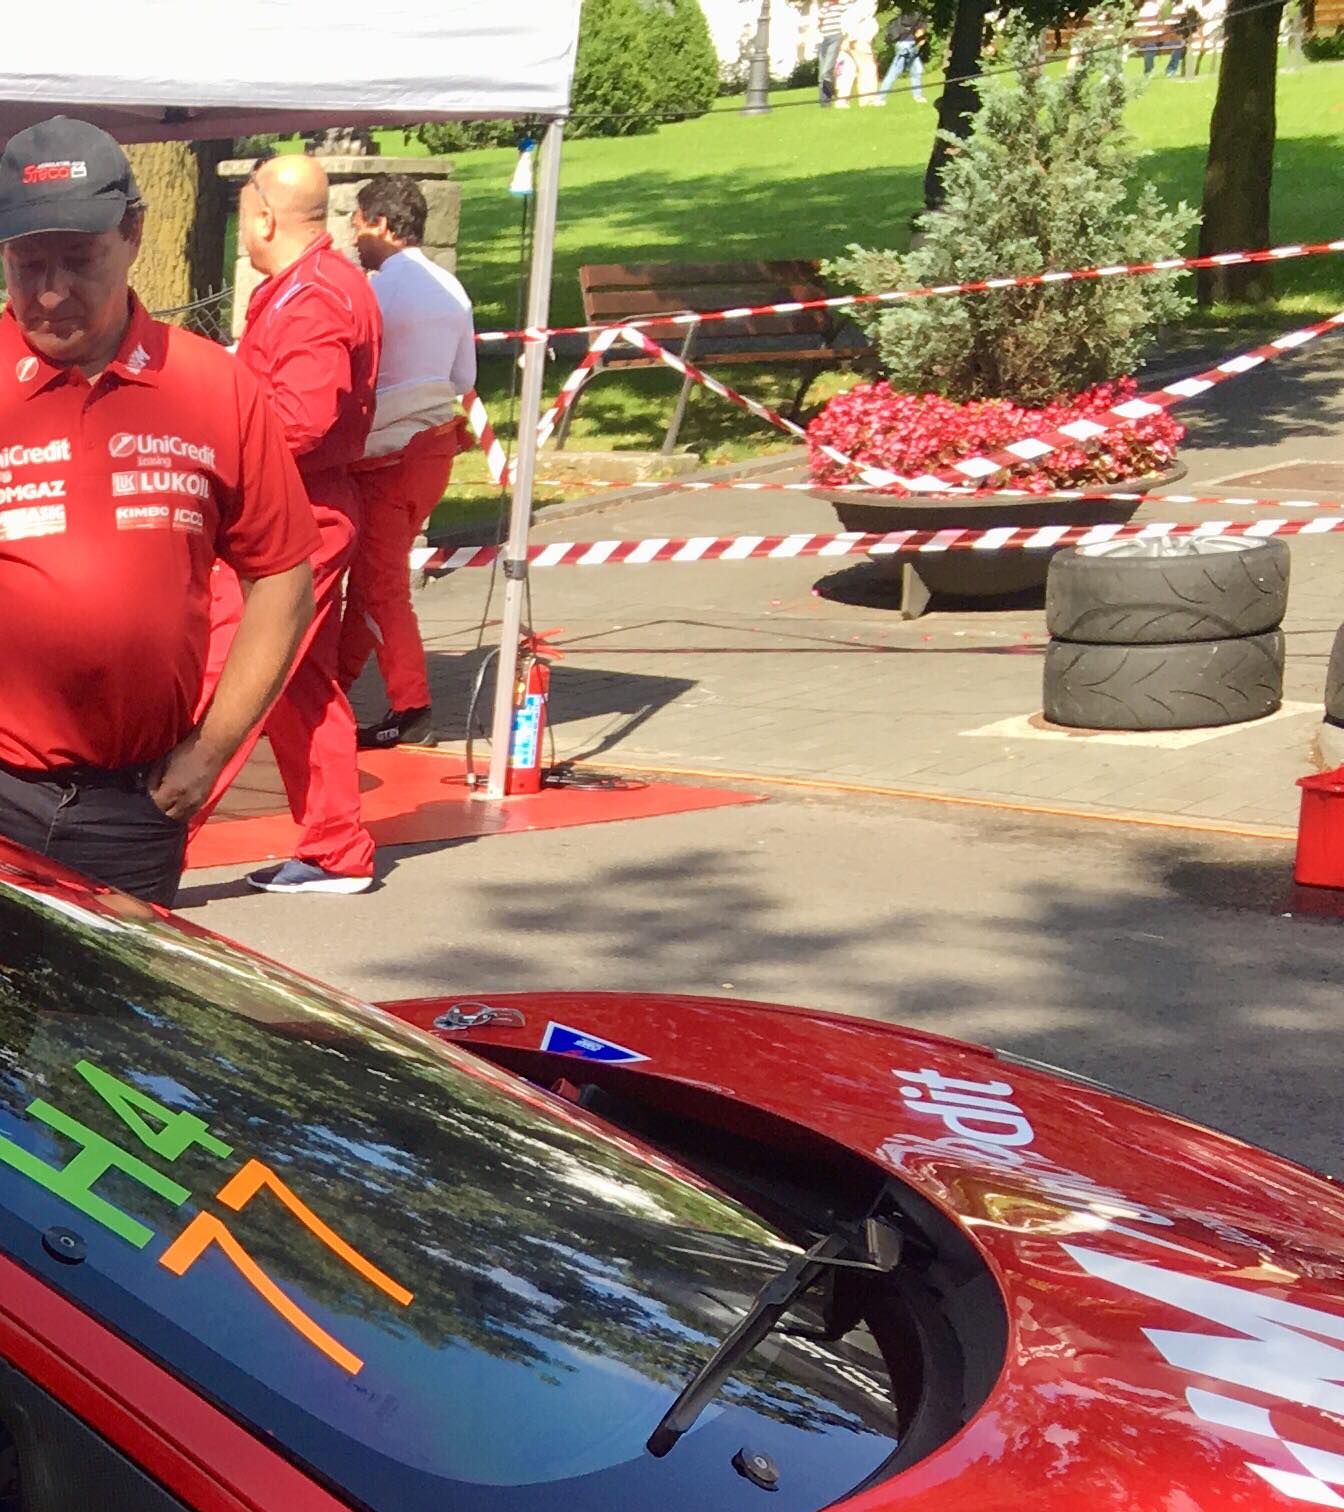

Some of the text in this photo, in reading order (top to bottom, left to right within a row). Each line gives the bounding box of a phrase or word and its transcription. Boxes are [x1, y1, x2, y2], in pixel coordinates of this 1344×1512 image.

[137, 434, 215, 469] UniCredit
[141, 472, 209, 498] LUKOIL
[116, 506, 170, 519] KIMBO
[159, 1158, 415, 1375] 77
